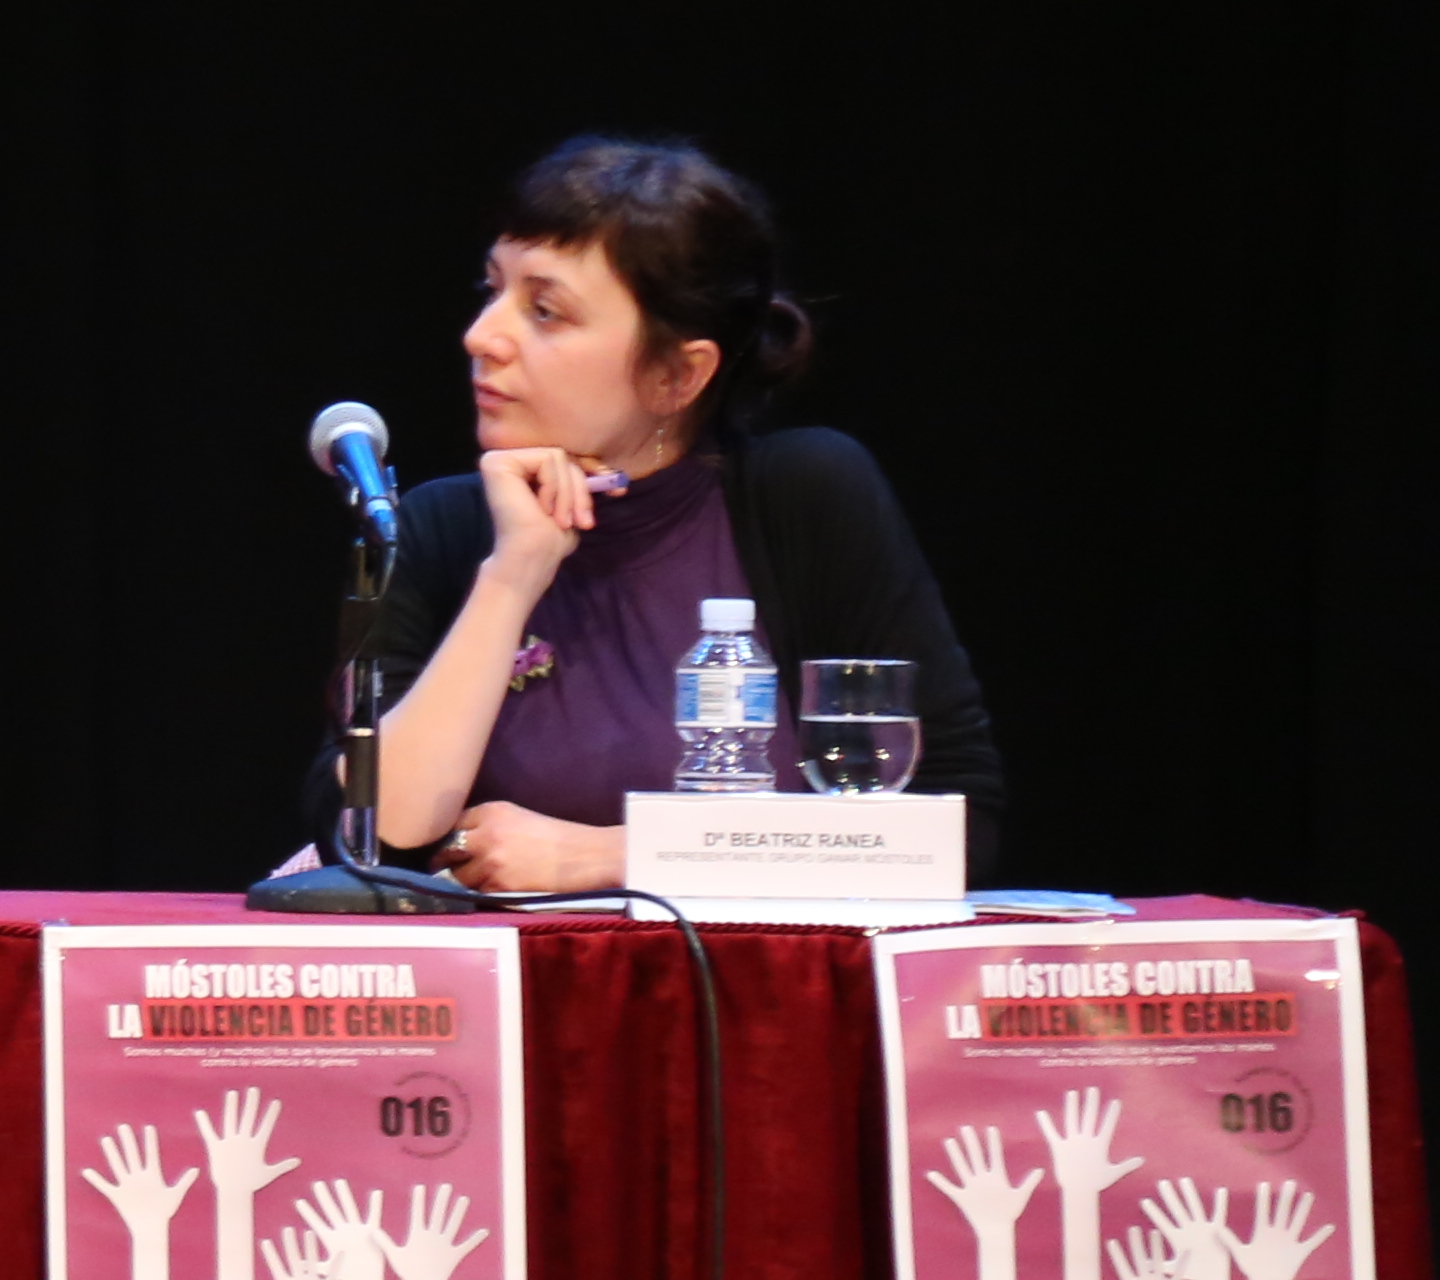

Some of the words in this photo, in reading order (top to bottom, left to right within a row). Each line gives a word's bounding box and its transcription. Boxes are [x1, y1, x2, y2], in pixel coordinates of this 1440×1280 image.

[730, 833, 813, 847] BEATRIZ
[818, 833, 886, 848] RANEA
[145, 959, 294, 999] MÓSTOLES
[299, 964, 417, 999] CONTRA
[981, 958, 1130, 999] MÓSTOLES
[1134, 959, 1255, 995] CONTRA
[107, 1004, 143, 1039] LA
[148, 1004, 295, 1037] VIOLENCIA
[303, 1004, 336, 1037] DE
[345, 998, 453, 1037] GÉNERO
[946, 1005, 981, 1039] LA
[1139, 1001, 1172, 1034] DE
[380, 1096, 452, 1138] 016
[1220, 1091, 1294, 1133] 016
